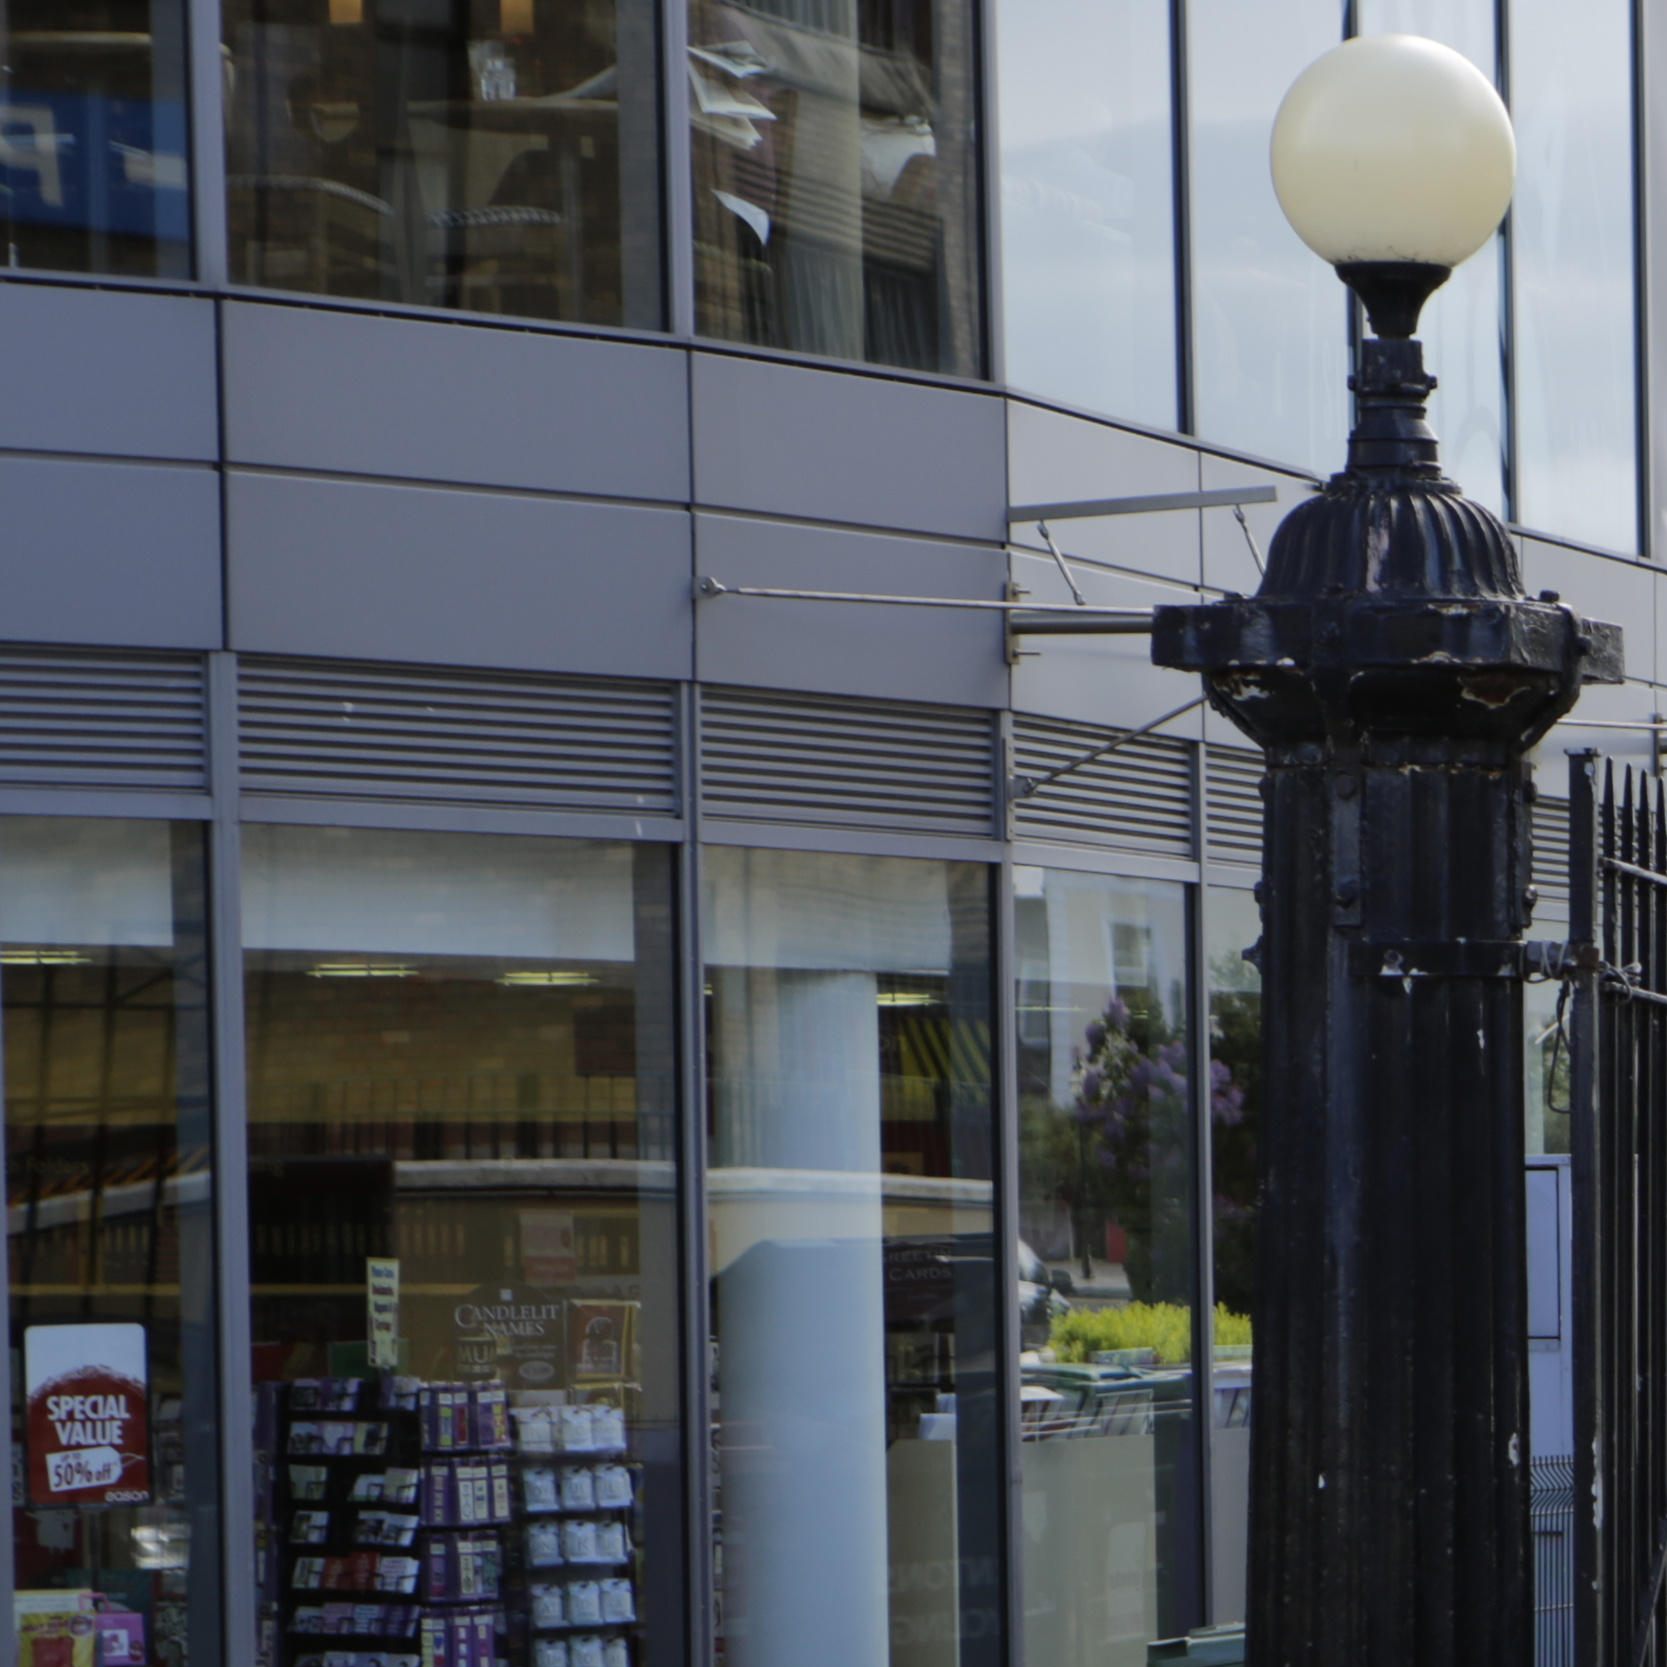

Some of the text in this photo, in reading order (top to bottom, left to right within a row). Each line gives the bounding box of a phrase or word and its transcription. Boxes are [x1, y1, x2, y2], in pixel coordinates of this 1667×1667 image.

[454, 1304, 560, 1328] CANDLELIT
[483, 1321, 545, 1338] NAMES
[46, 1395, 132, 1421] SPECIAL
[54, 1420, 125, 1446] VALUE
[54, 1462, 93, 1488] 50%
[105, 1490, 149, 1503] eason
